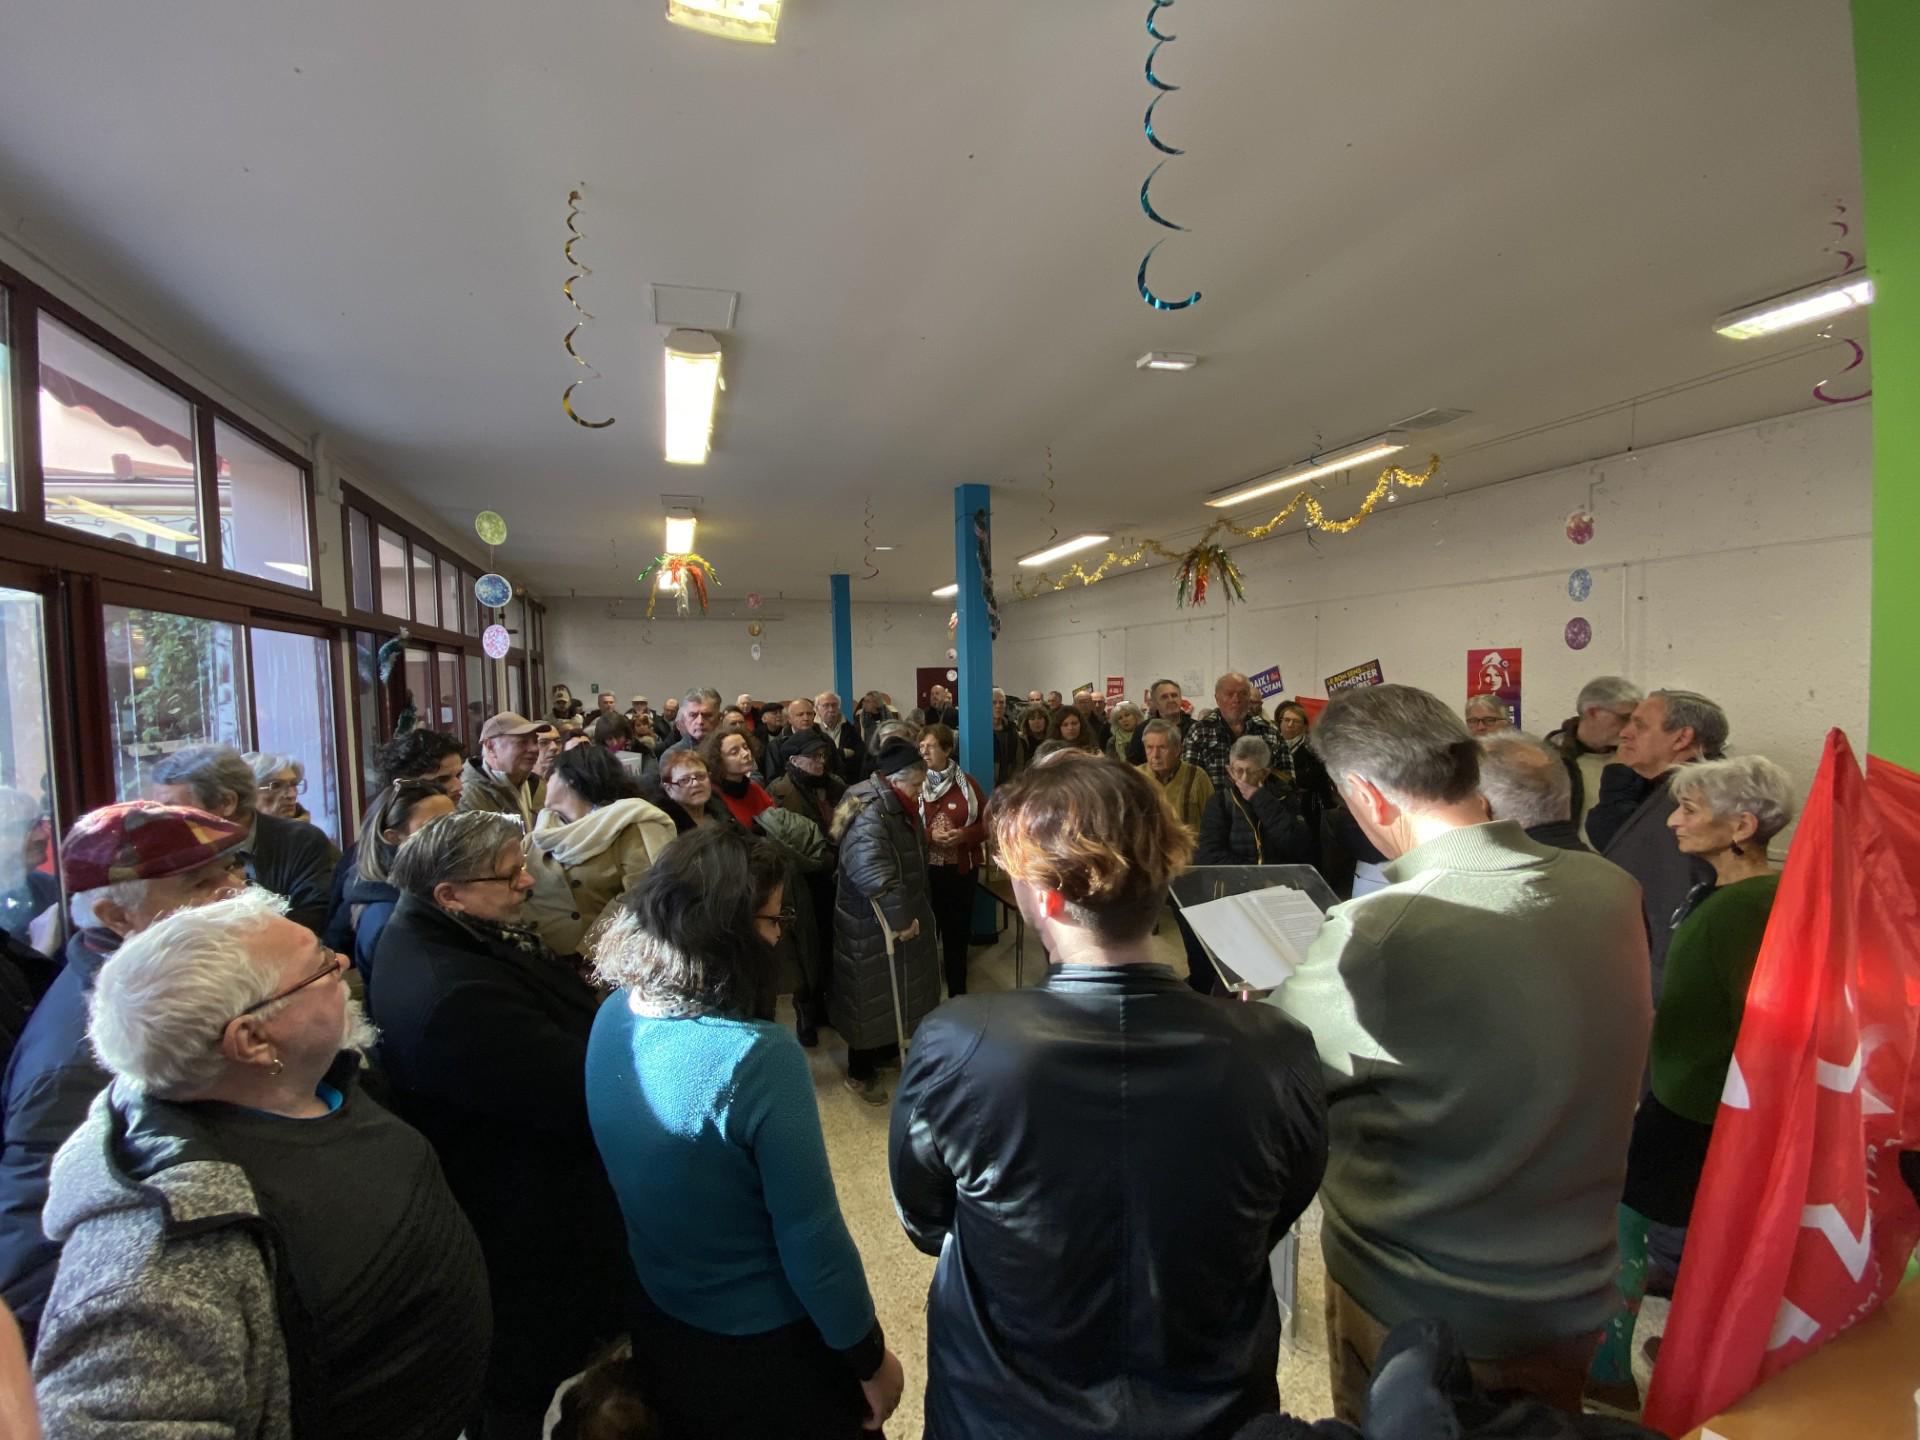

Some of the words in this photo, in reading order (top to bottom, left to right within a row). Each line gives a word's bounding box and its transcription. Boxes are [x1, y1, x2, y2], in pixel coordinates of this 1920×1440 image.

[1328, 669, 1378, 692] AUGMENTER
[1334, 671, 1347, 682] BON
[1346, 667, 1362, 679] SENS
